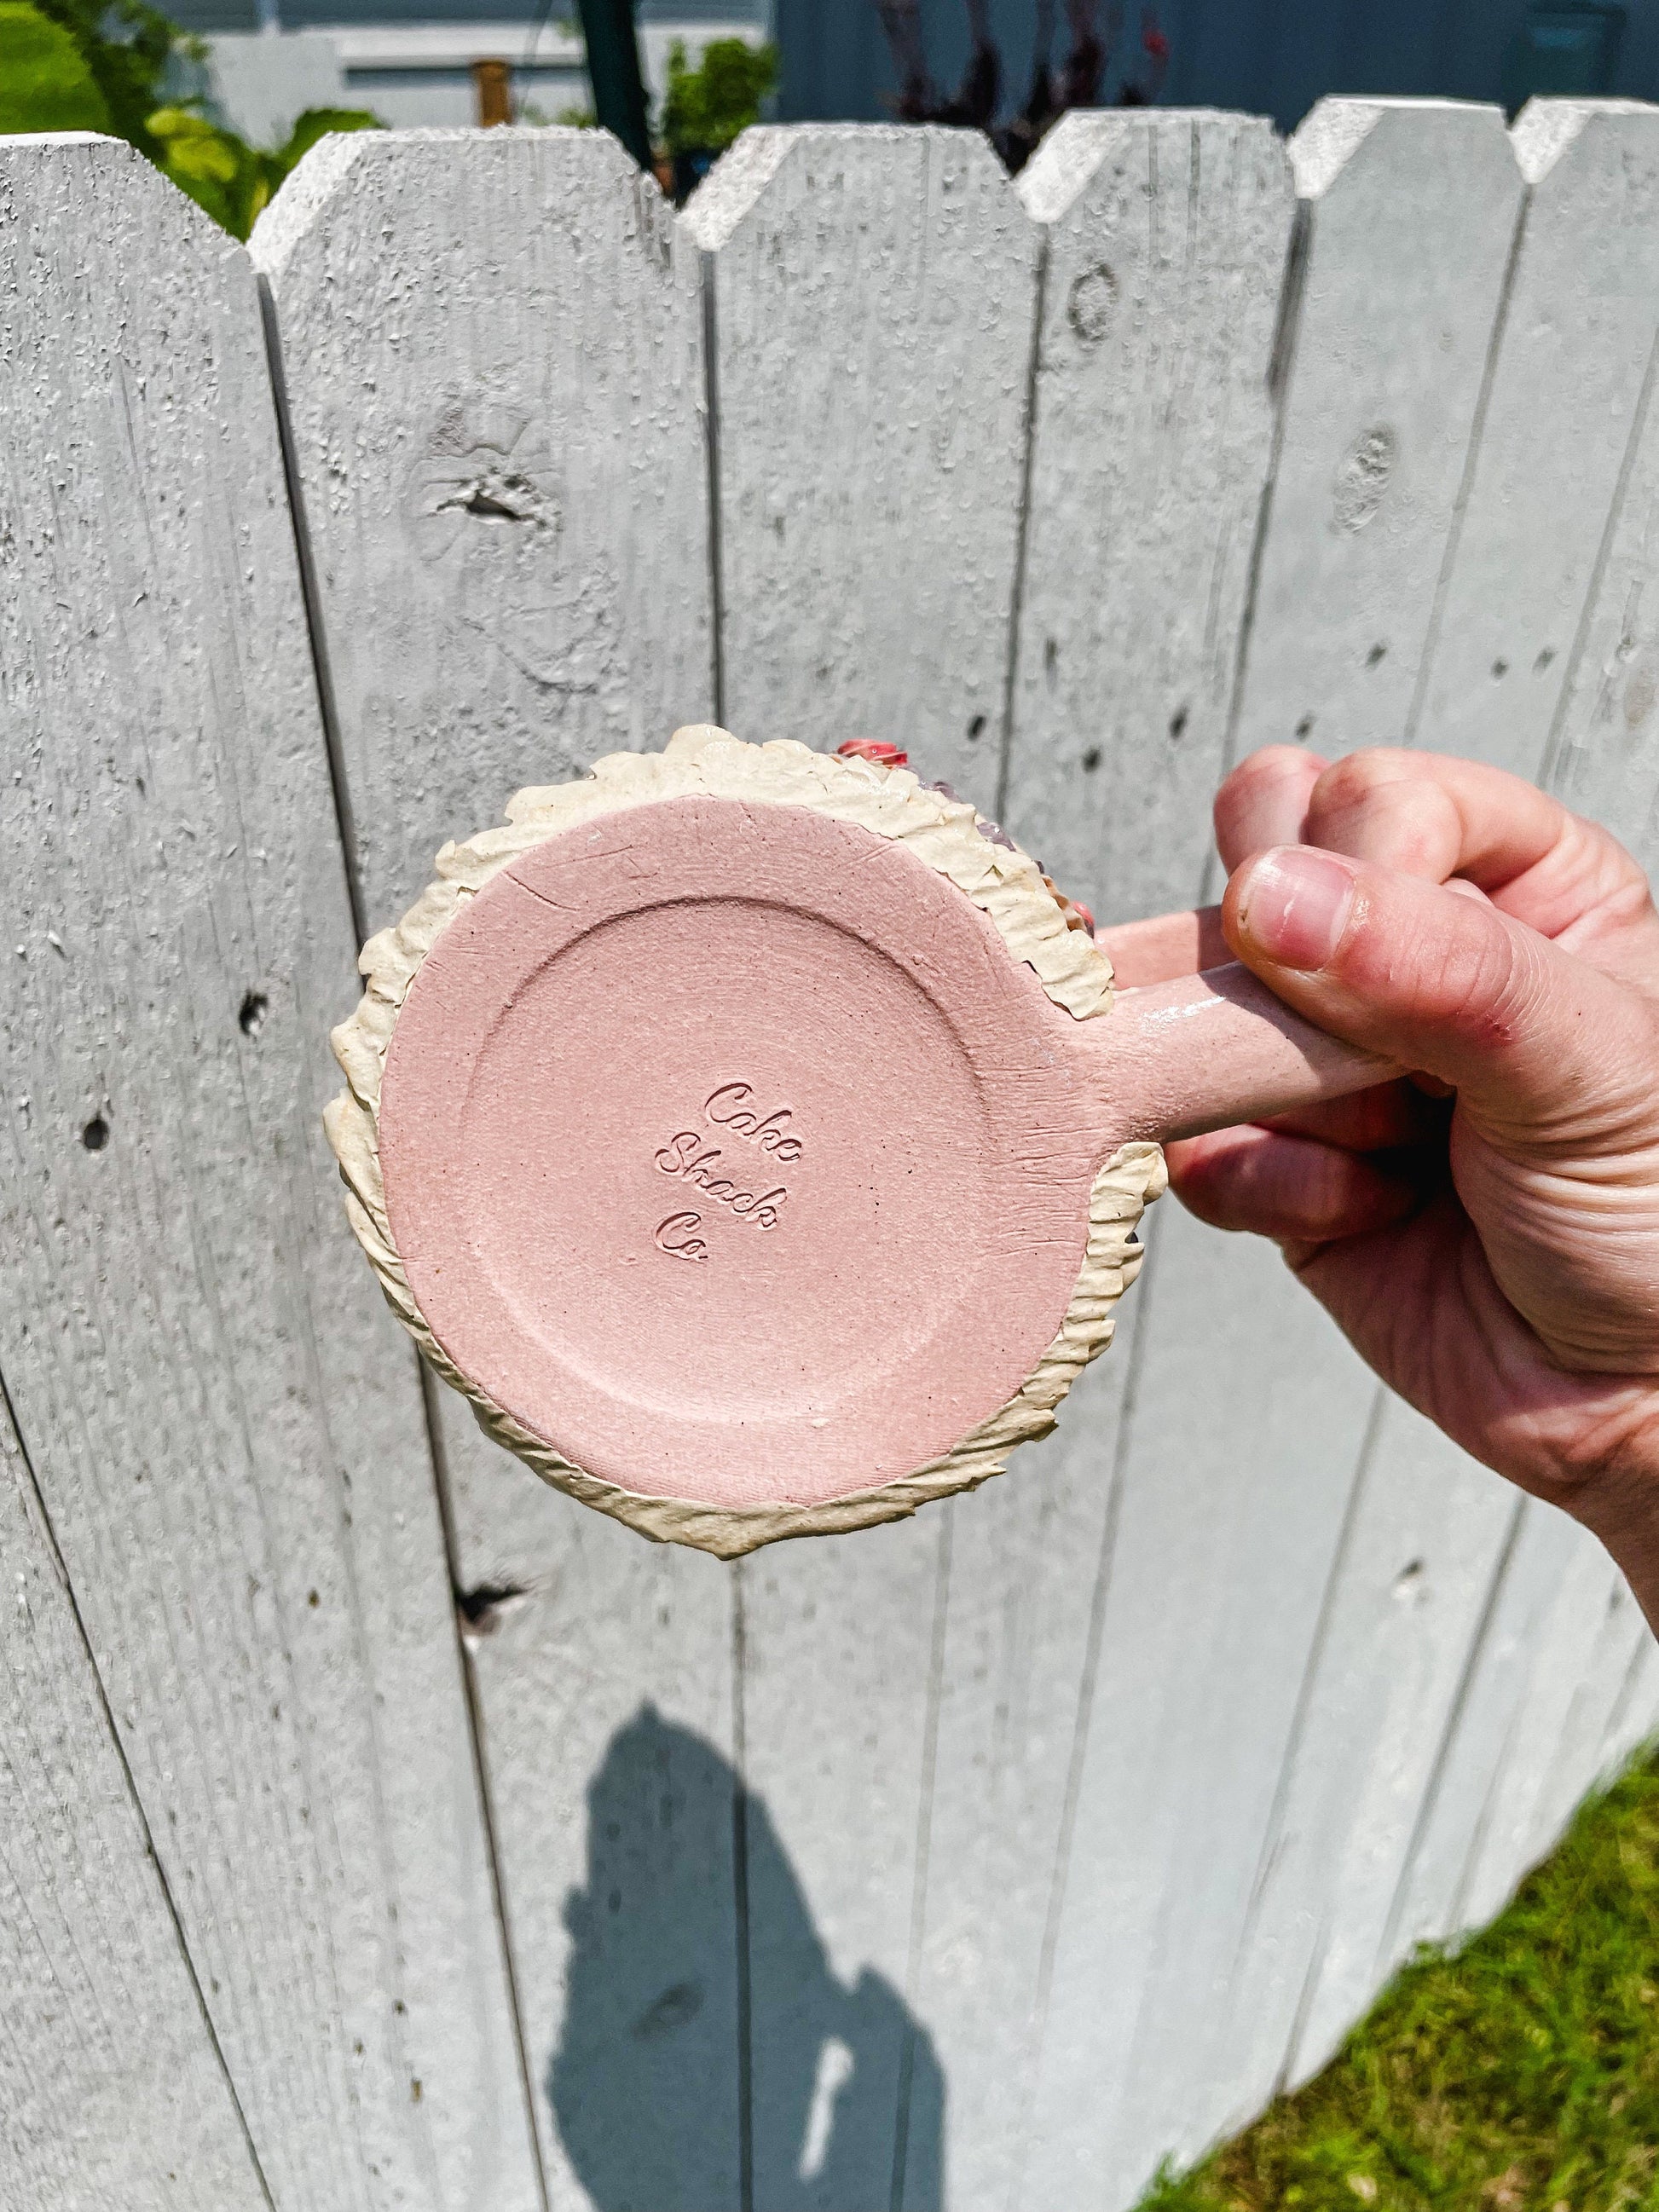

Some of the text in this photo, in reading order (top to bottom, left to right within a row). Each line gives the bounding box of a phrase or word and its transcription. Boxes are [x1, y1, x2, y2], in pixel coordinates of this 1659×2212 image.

[704, 1082, 803, 1162] Cake
[654, 1131, 788, 1229] Shack
[654, 1211, 708, 1259] Co
